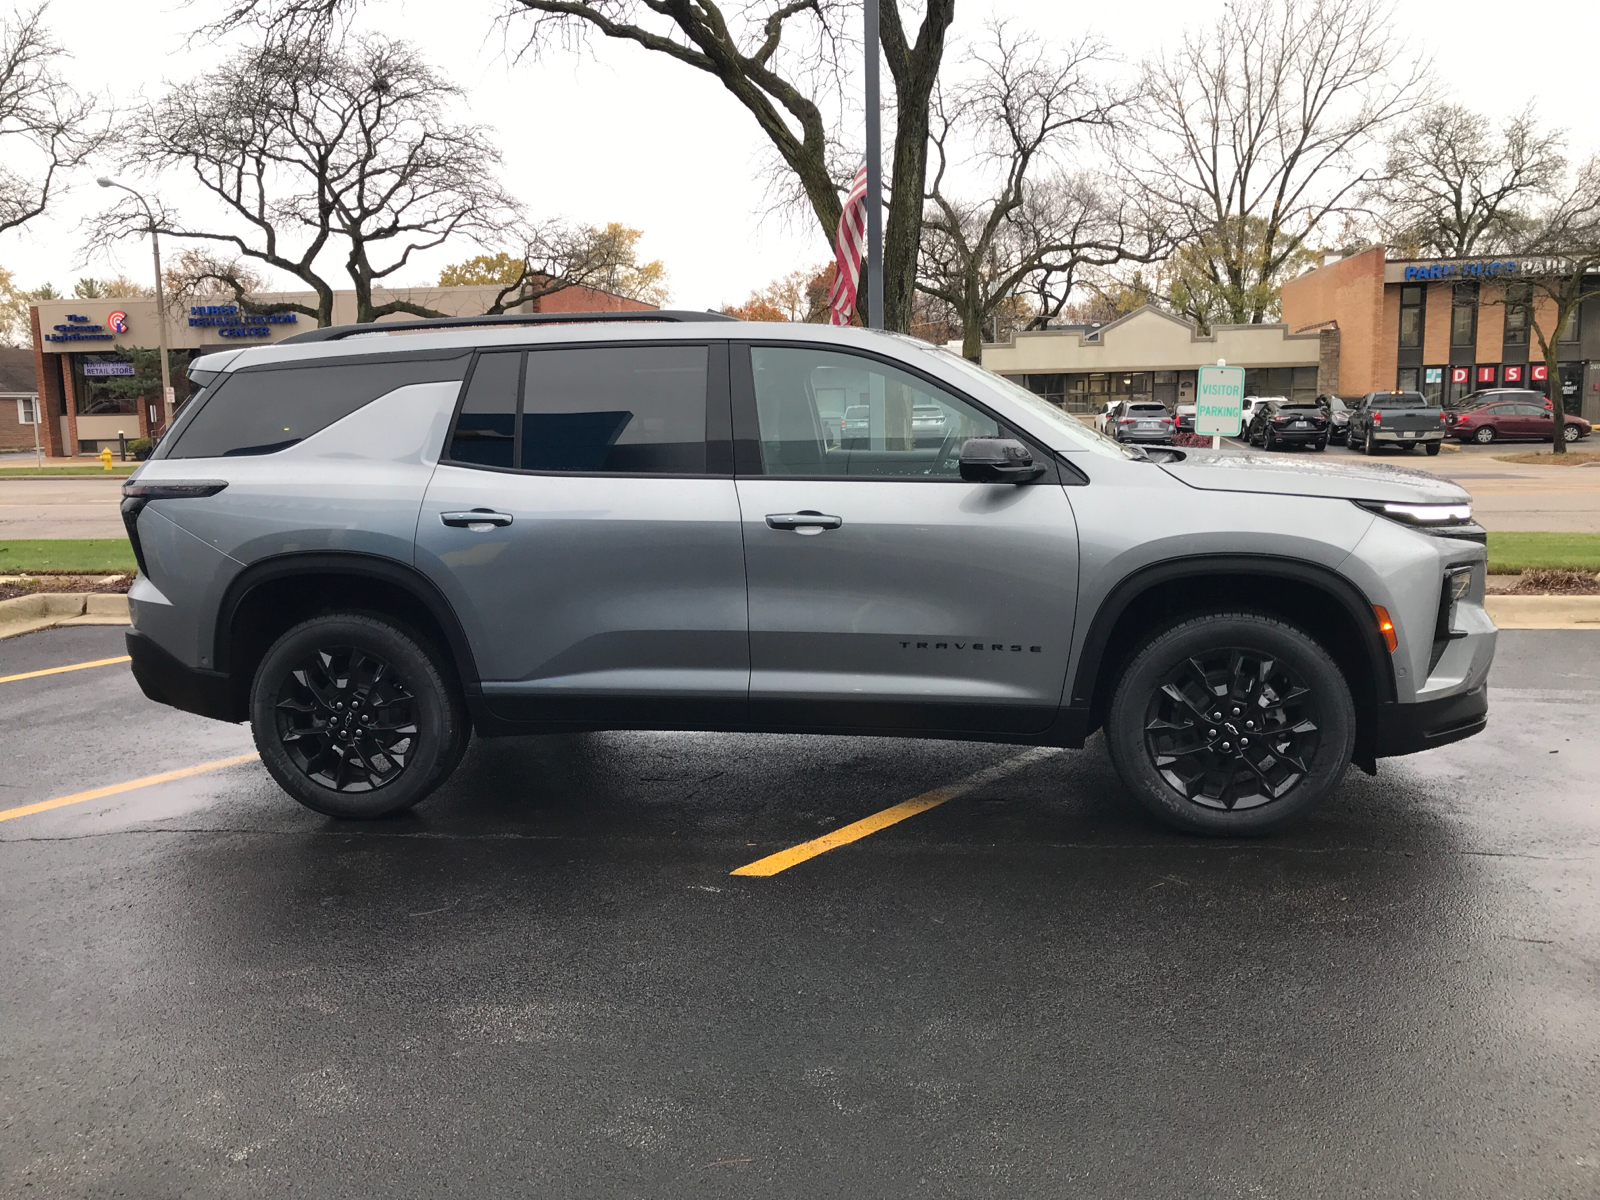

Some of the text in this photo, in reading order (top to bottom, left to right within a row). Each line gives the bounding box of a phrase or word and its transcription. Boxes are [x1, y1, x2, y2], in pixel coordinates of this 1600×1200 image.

[190, 305, 237, 315] HUBER
[65, 314, 89, 322] The
[188, 314, 298, 327] REHABILITATION
[53, 324, 103, 333] Chicago
[218, 326, 271, 337] CENTER
[45, 333, 113, 343] Lighthouse
[111, 367, 133, 375] STORE
[1202, 384, 1239, 396] VISITOR
[1200, 405, 1239, 418] PARKING
[899, 642, 1042, 652] TRAVERSE
